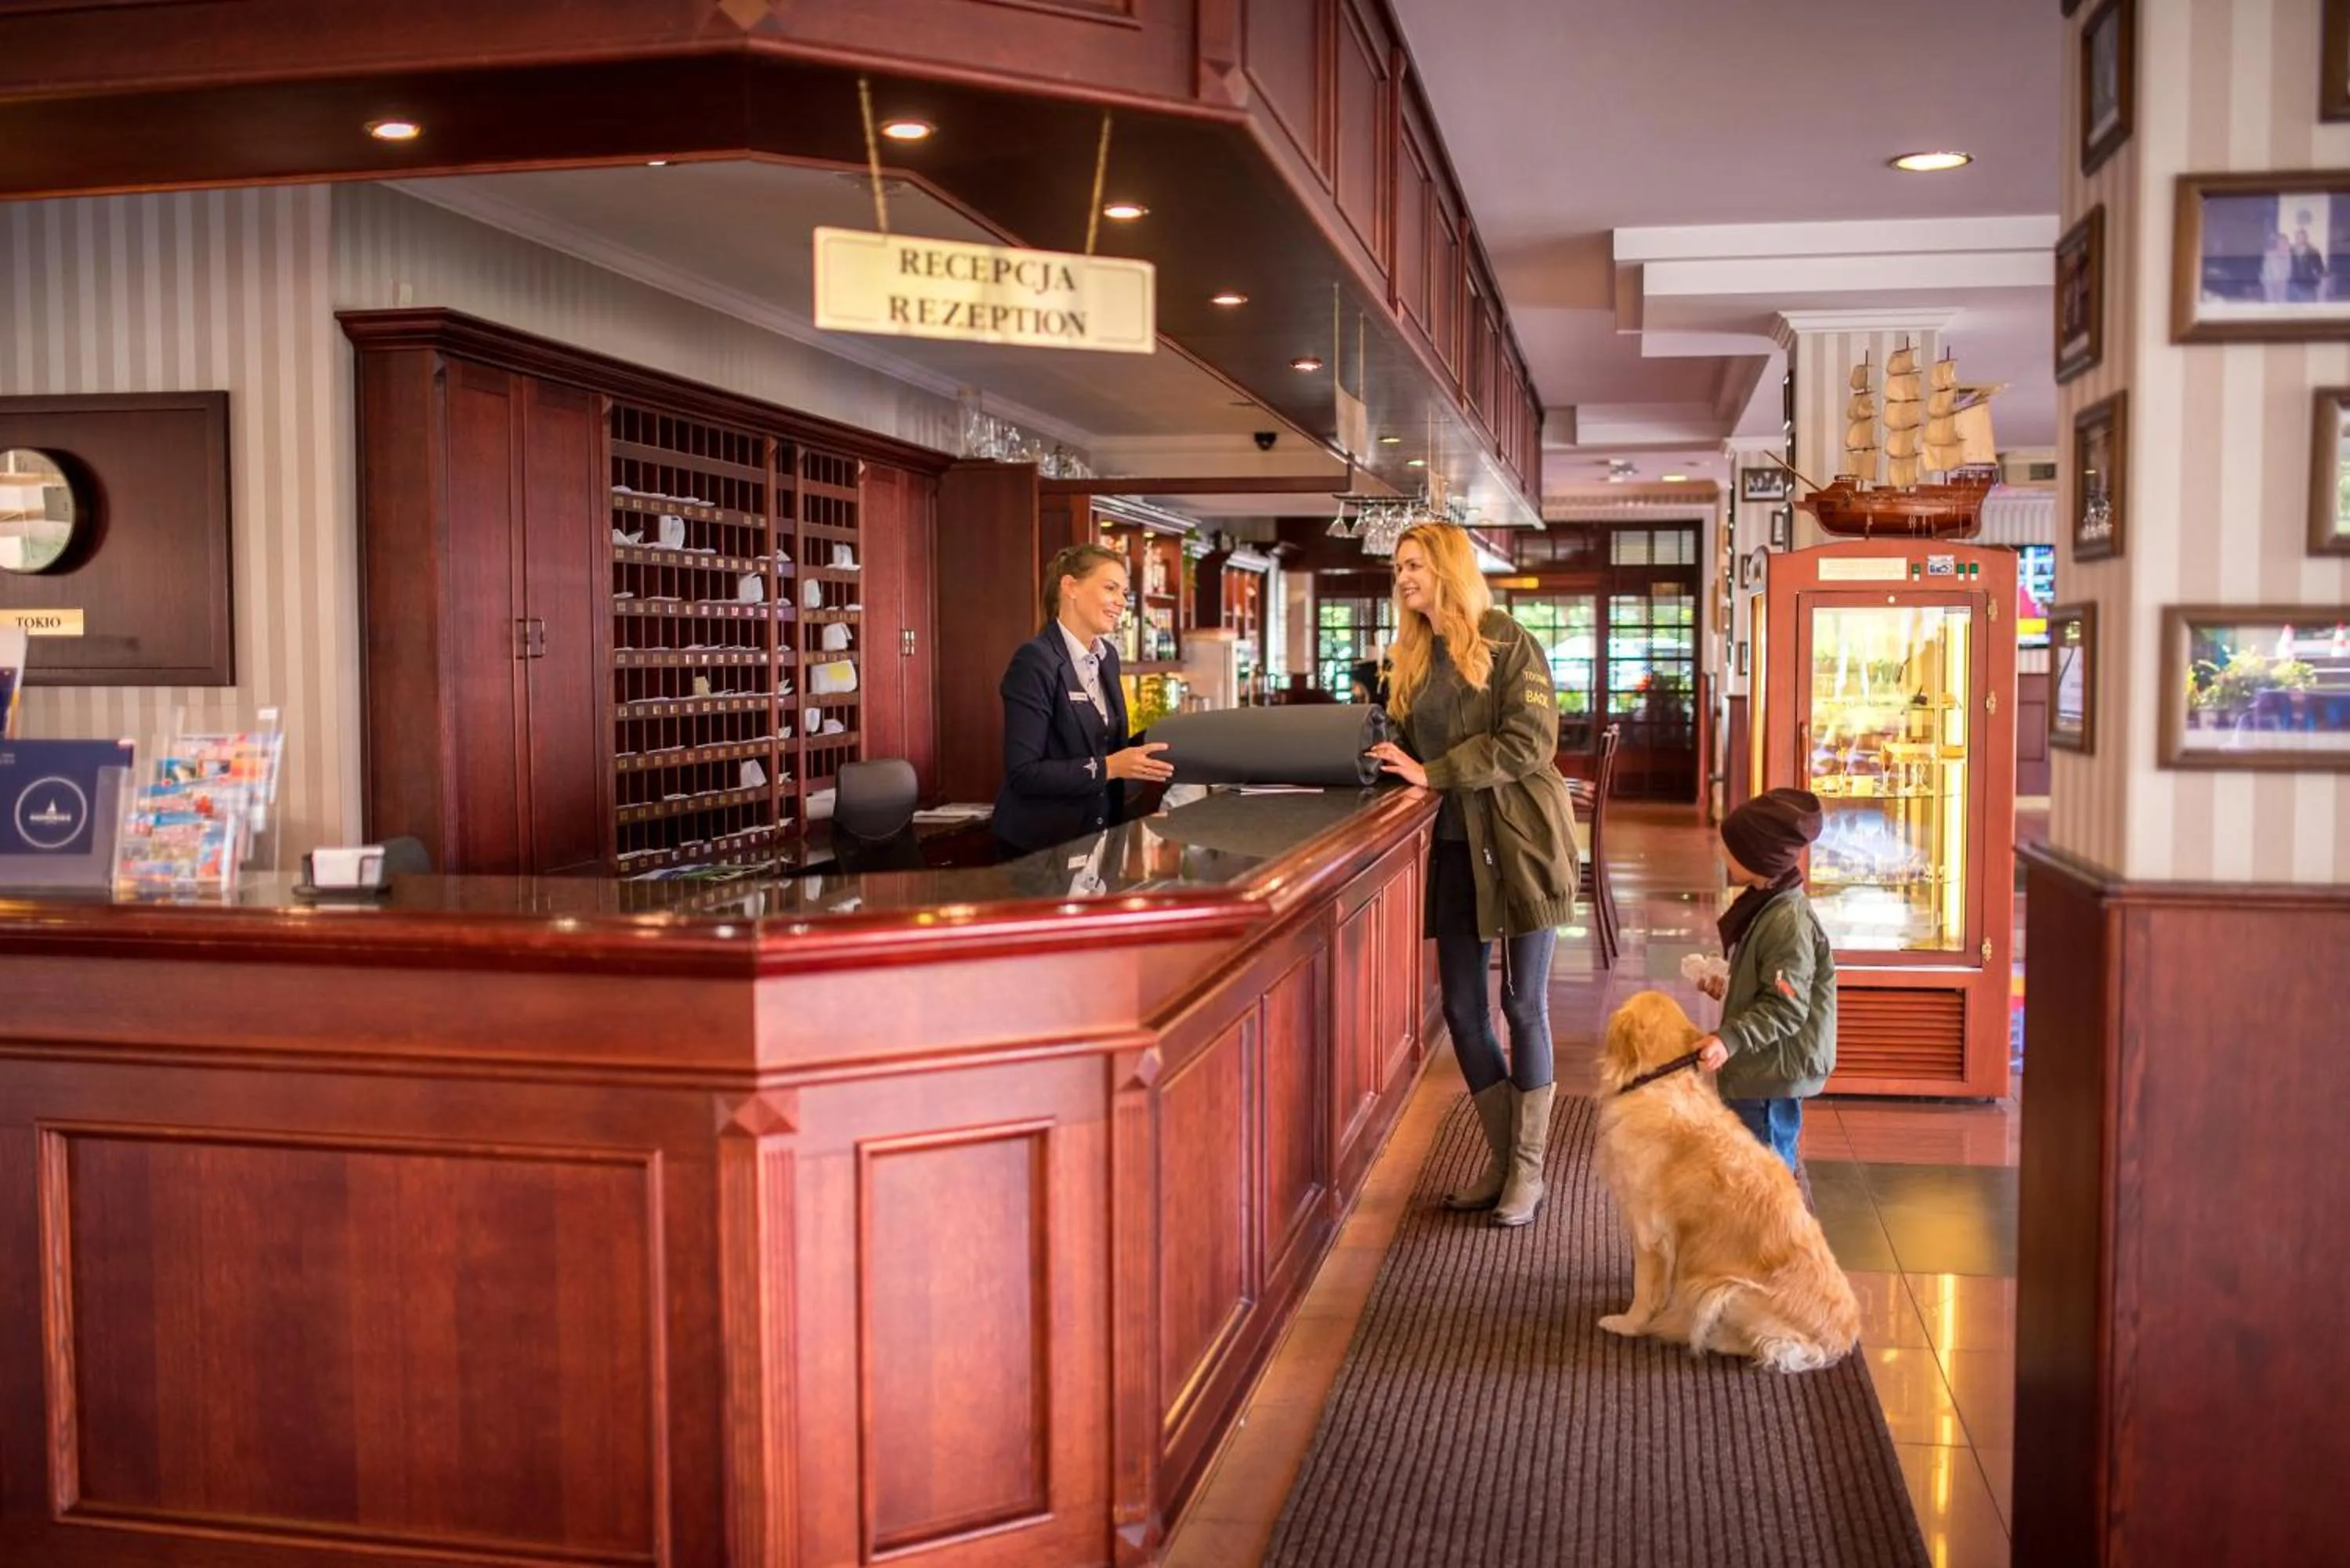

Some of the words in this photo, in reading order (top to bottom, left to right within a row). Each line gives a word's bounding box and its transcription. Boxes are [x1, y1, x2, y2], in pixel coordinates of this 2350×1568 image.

[900, 249, 1076, 294] RECEPCJA
[890, 296, 1087, 336] REZEPTION
[15, 616, 61, 628] TOKIO
